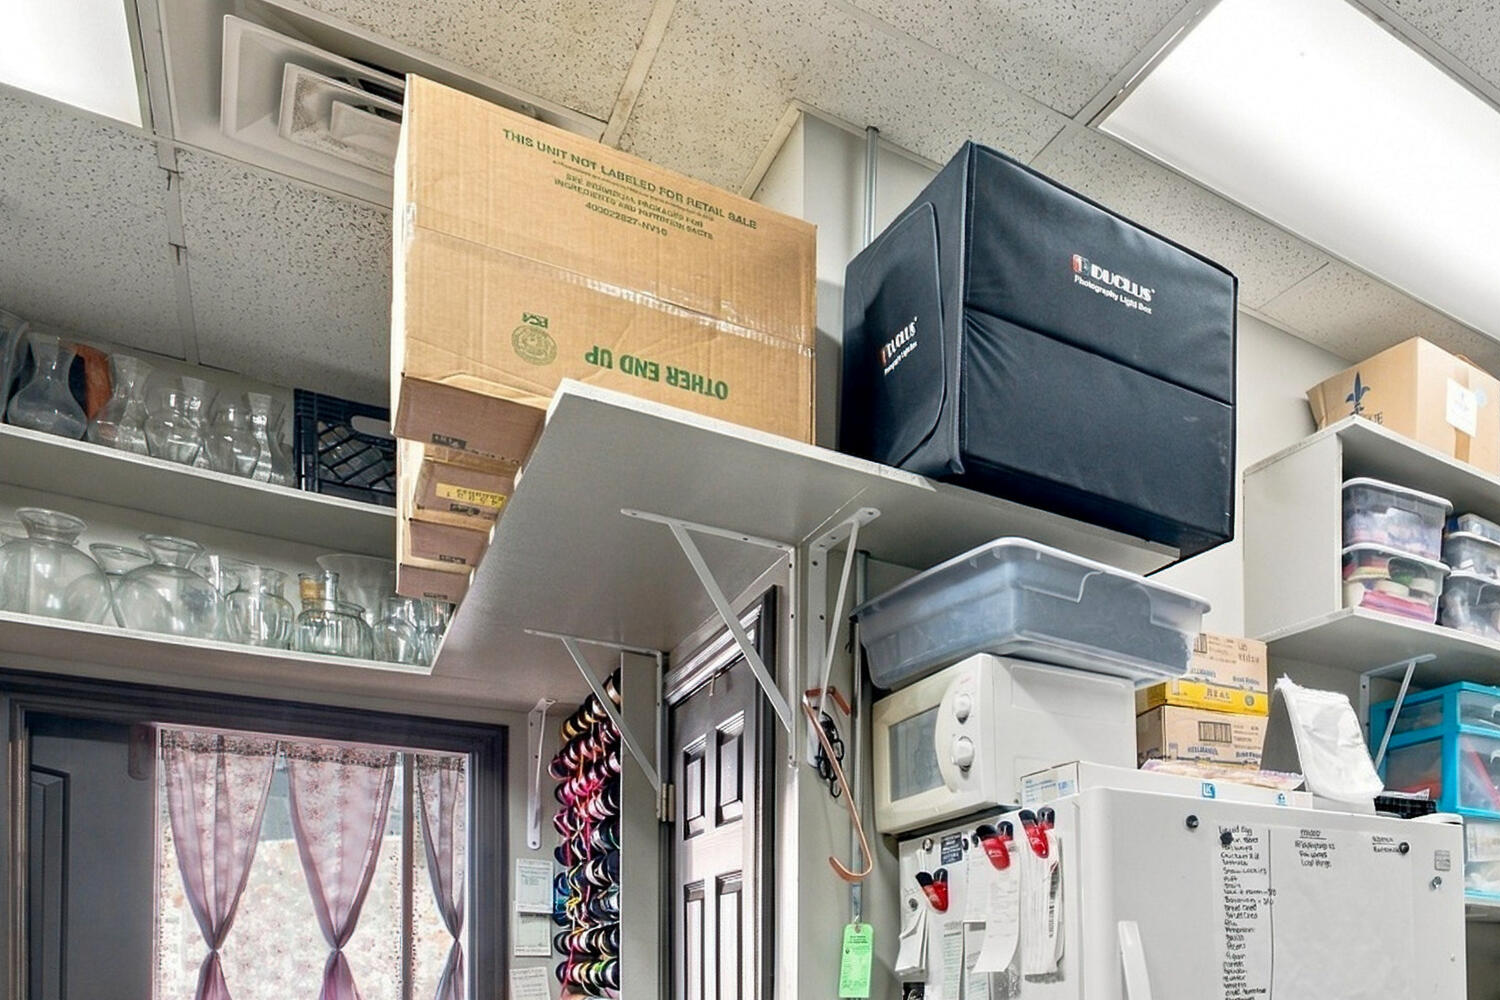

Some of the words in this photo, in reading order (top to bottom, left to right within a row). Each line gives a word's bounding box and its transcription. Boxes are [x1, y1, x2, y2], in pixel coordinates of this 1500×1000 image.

[502, 128, 534, 148] THIS
[537, 141, 568, 159] UNIT
[571, 154, 597, 171] NOT
[601, 165, 656, 193] LABELED
[659, 186, 683, 203] FOR
[687, 197, 725, 217] RETAIL
[728, 212, 757, 229] SALE
[585, 345, 613, 369] UP
[619, 354, 660, 382] END
[665, 365, 729, 400] OTHER
